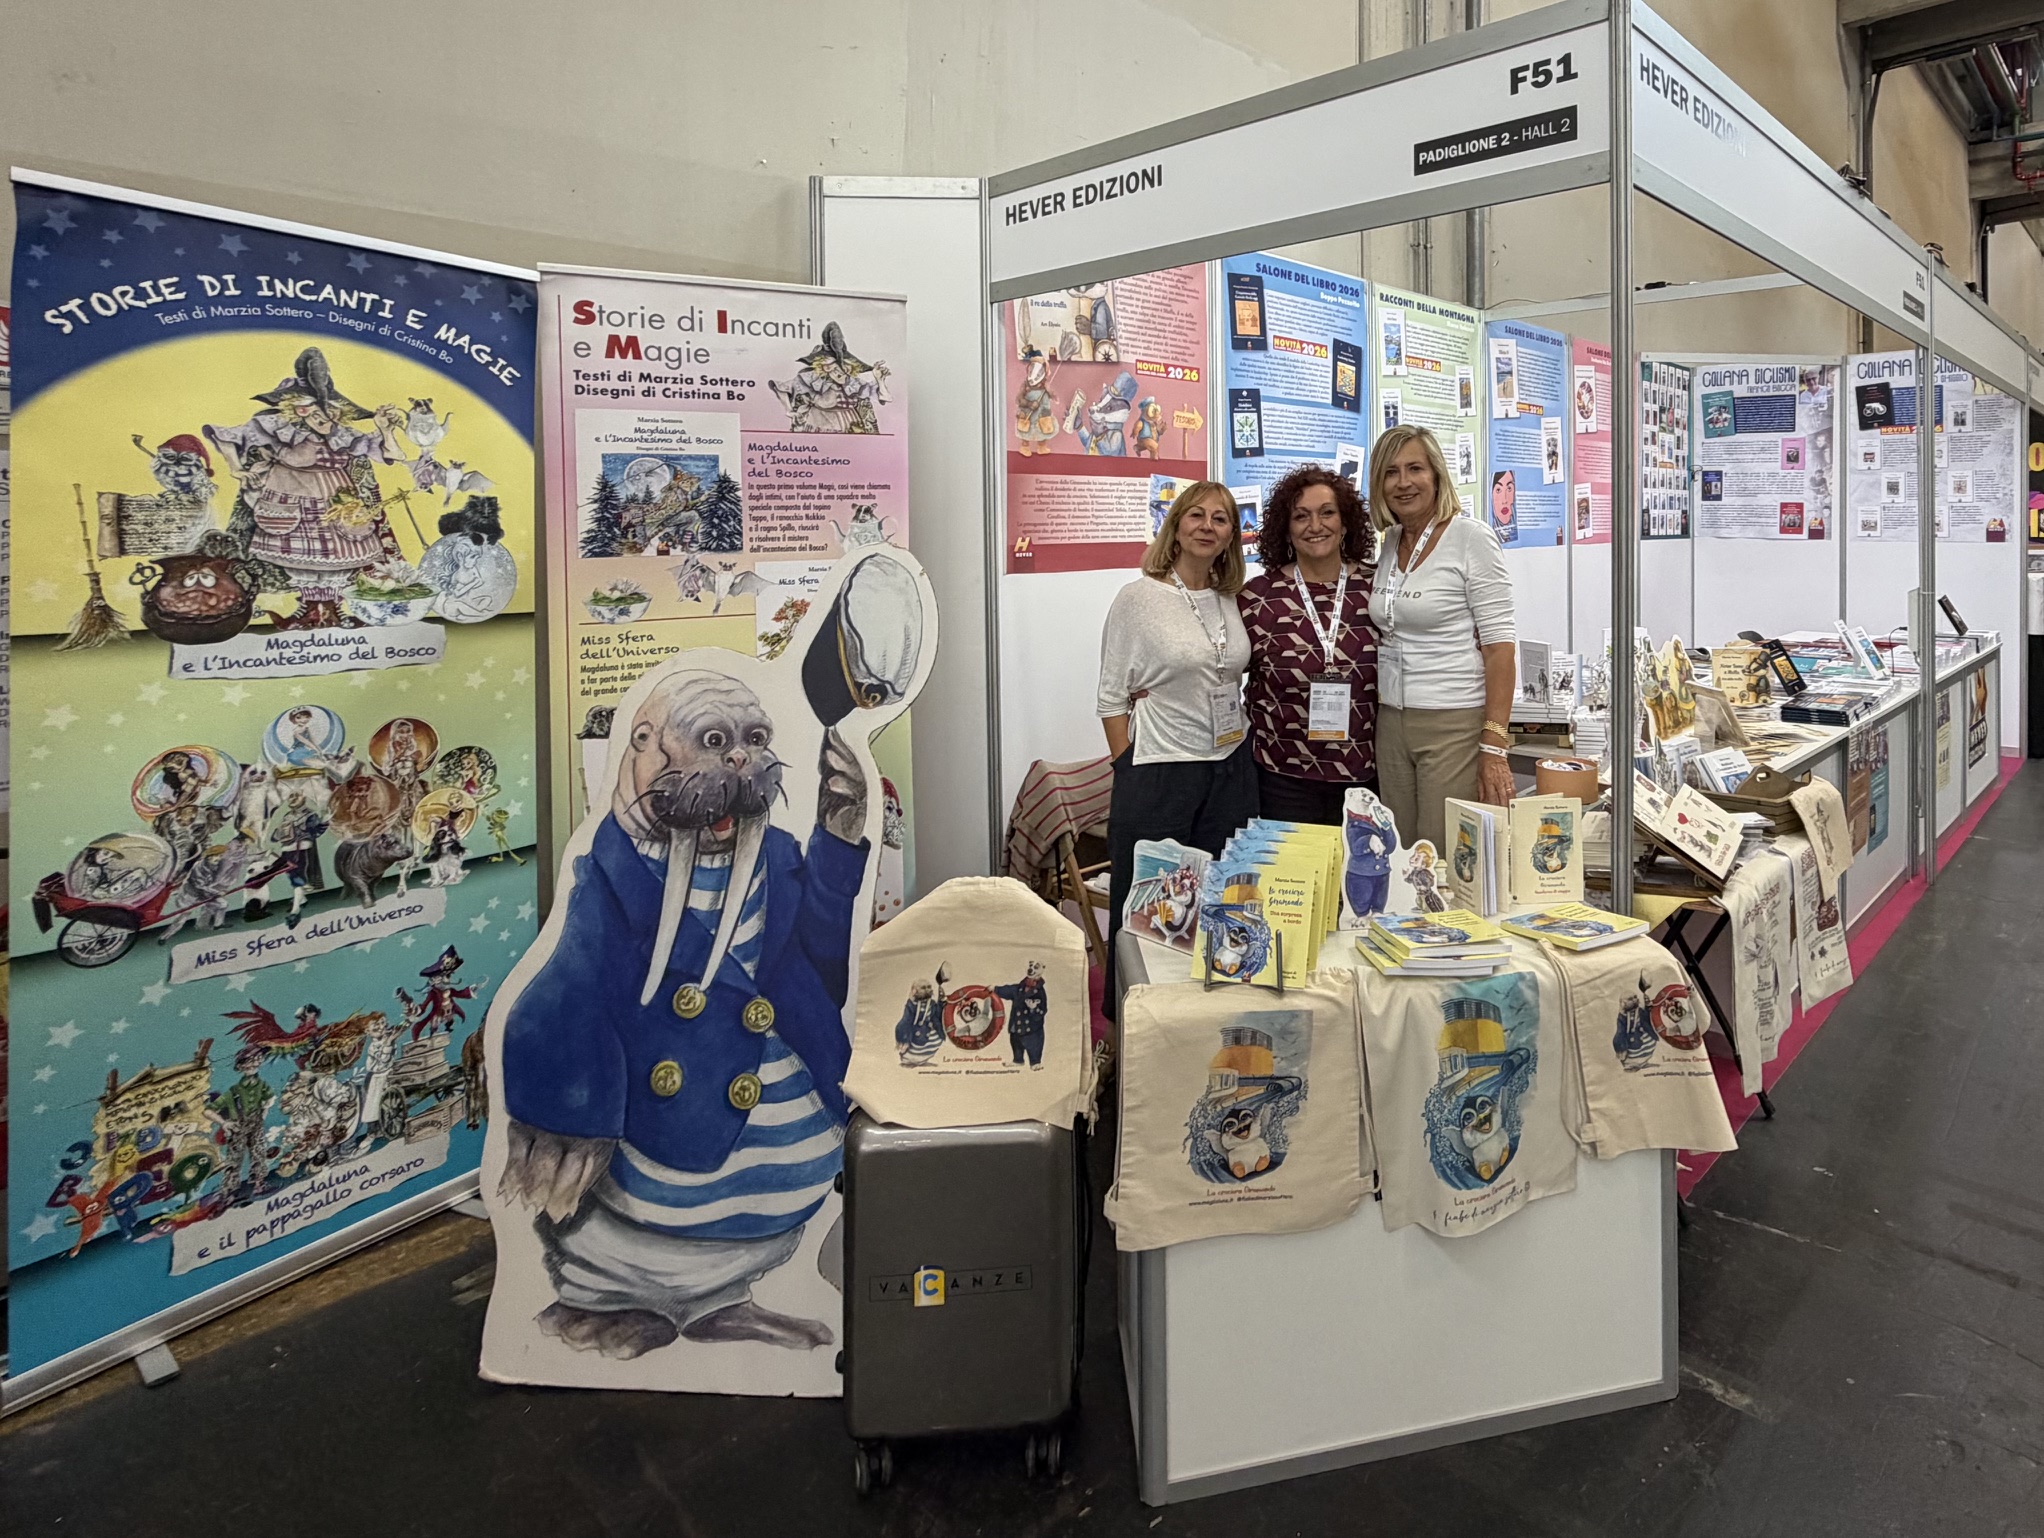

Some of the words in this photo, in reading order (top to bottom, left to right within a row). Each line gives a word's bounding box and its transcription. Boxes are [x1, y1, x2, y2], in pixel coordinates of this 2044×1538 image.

[1510, 52, 1578, 96] F51
[1639, 52, 1689, 116] HEVER
[1693, 95, 1746, 158] EDIZIONI
[1418, 134, 1498, 165] PADIGLIONE
[1500, 132, 1511, 146] 2
[1522, 121, 1557, 142] HALL
[1560, 118, 1571, 132] 2
[1005, 191, 1066, 227] HEVER
[1072, 164, 1163, 209] EDIZIONI
[1255, 262, 1293, 281] SALONE
[1294, 272, 1310, 286] DEL
[1312, 276, 1337, 292] LIBRO
[1338, 283, 1360, 298] 2026
[1379, 292, 1415, 310] RACCONTI
[1416, 301, 1437, 315] DELLA
[1438, 307, 1475, 325] MONTAGNA
[572, 299, 666, 330] Storie
[677, 305, 704, 333] di
[717, 309, 812, 340] Incanti
[44, 276, 187, 335] STORIE
[197, 273, 243, 298] DI
[256, 275, 395, 320] INCANTI
[405, 308, 428, 331] E
[434, 322, 522, 387] MAGIE
[154, 309, 189, 327] Testi
[192, 304, 207, 320] di
[211, 303, 262, 317] Marzia
[265, 304, 314, 320] Sottero
[328, 310, 376, 332] Disegni
[379, 320, 392, 337] di
[394, 329, 438, 357] Cristina
[438, 349, 454, 365] Bo
[1504, 325, 1526, 338] SALONE
[1525, 331, 1536, 341] DEL
[573, 340, 592, 359] e
[604, 333, 711, 371] Magie
[1273, 338, 1301, 350] NOVITÀ
[1301, 343, 1328, 358] 2026
[1136, 361, 1166, 373] NOVITÀ
[1167, 366, 1199, 382] 2026
[1423, 360, 1441, 371] 2026
[1857, 358, 1913, 380] COLLANA
[573, 369, 611, 382] Testi
[617, 370, 633, 383] di
[638, 371, 695, 386] Marzia
[699, 374, 756, 388] Sottero
[1702, 368, 1749, 388] COLLANA
[574, 384, 636, 400] Disegni
[641, 385, 656, 398] di
[661, 386, 721, 401] Cristina
[726, 390, 746, 401] Bo
[604, 433, 673, 444] l'Incantesimo
[676, 435, 693, 445] del
[696, 436, 724, 445] Bosco
[634, 426, 687, 437] Magdaluna
[1880, 426, 1911, 435] NOVITÀ
[747, 442, 819, 454] Magdaluna
[761, 453, 851, 466] l'Incantesimo
[747, 467, 770, 478] del
[776, 469, 814, 479] Bosco
[756, 483, 776, 492] questo
[777, 483, 795, 492] primo
[796, 482, 817, 490] volume
[748, 493, 764, 502] dagli
[817, 493, 823, 501] di
[836, 494, 860, 502] squadra
[861, 493, 877, 501] molto
[748, 503, 773, 512] speciale
[813, 504, 832, 513] topino
[776, 514, 804, 522] ranocchio
[755, 535, 781, 543] risolvere
[798, 543, 808, 552] del
[809, 543, 828, 552] Bosco?
[778, 578, 796, 586] Miss
[798, 576, 819, 587] Sfera
[265, 633, 369, 655] Magdaluna
[580, 635, 611, 646] Miss
[618, 630, 655, 646] Sfera
[182, 661, 196, 673] e
[204, 651, 342, 672] l'Incantesimo
[348, 645, 377, 660] del
[385, 645, 437, 659] Bosco
[580, 646, 680, 660] dell'Universo
[580, 663, 619, 675] Magdaluna
[587, 675, 597, 684] far
[599, 674, 618, 686] parte
[619, 672, 636, 682] della
[581, 686, 592, 696] del
[593, 685, 618, 697] grande
[194, 947, 238, 969] Miss
[246, 933, 298, 957] Sfera
[305, 902, 424, 940] dell'Universo
[265, 1164, 371, 1216] Magdaluna
[197, 1246, 212, 1259] e
[218, 1231, 237, 1251] il
[245, 1188, 353, 1248] pappagallo
[359, 1157, 425, 1191] corsaro
[879, 1272, 1024, 1297] VACANZE
